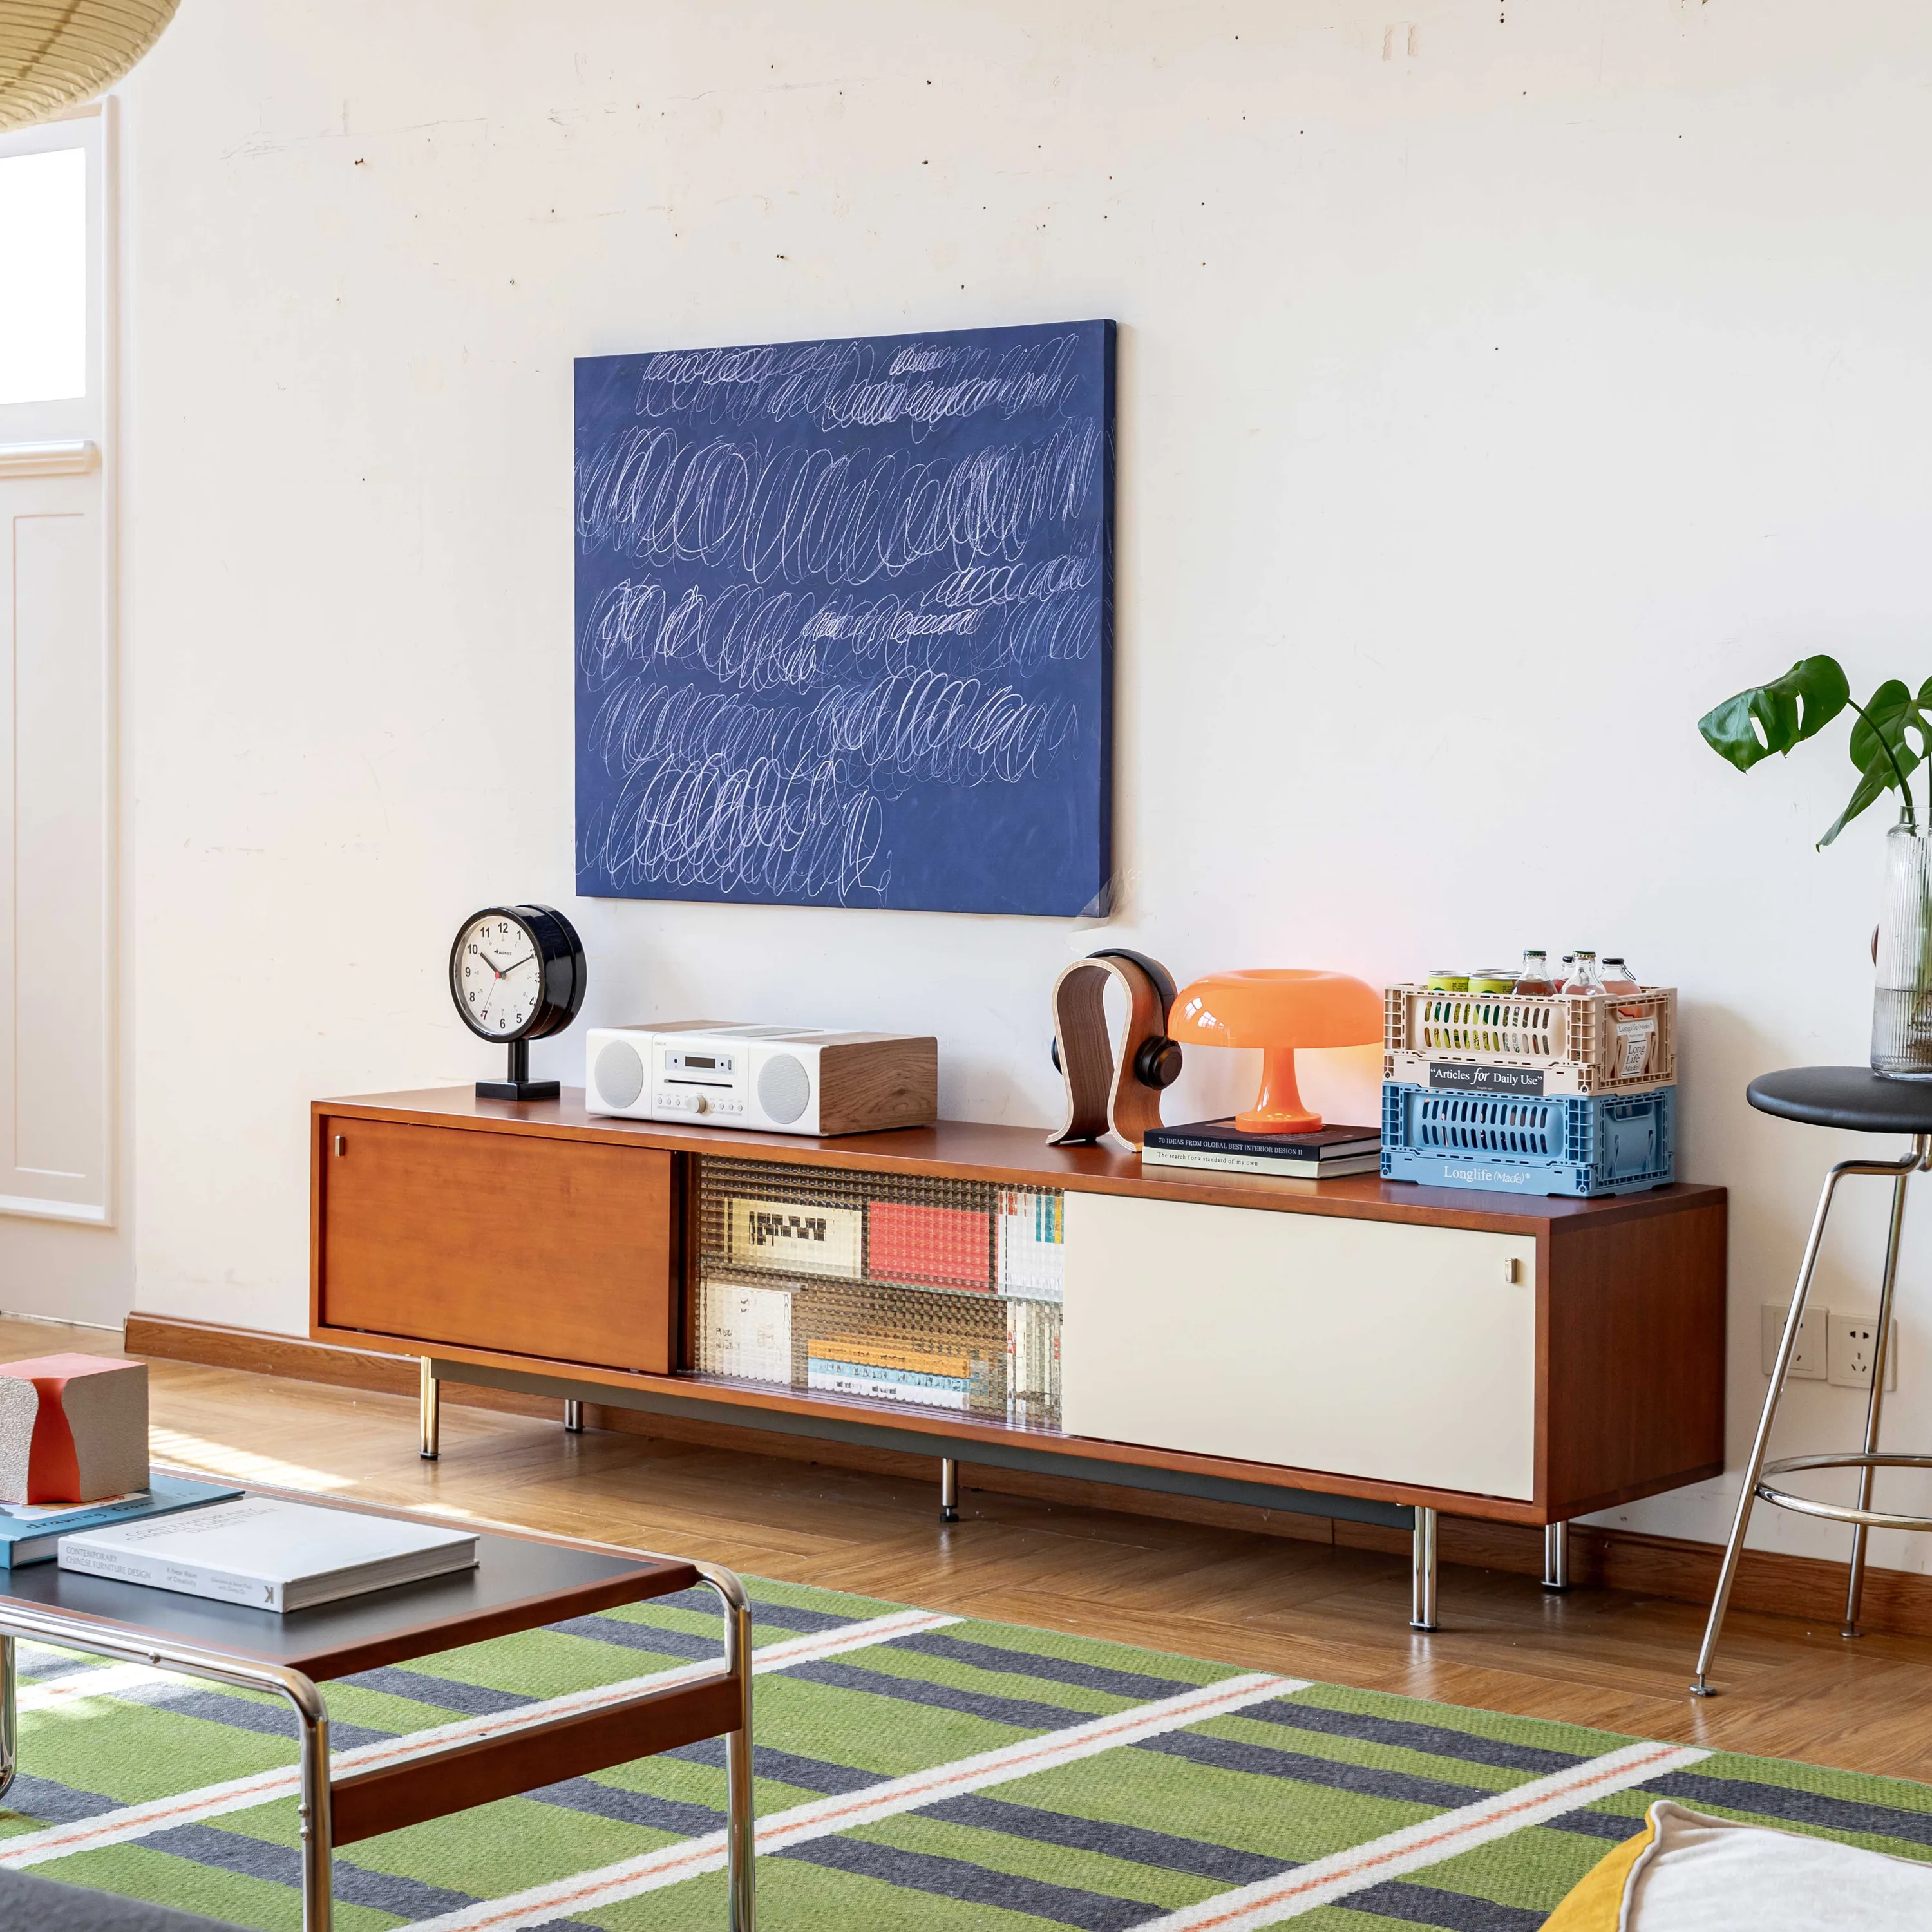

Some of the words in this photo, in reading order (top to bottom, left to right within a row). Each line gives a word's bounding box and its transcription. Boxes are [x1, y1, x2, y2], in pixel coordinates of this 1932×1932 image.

[480, 927, 490, 938] 11
[498, 922, 509, 933] 12
[517, 930, 521, 940] 1
[468, 943, 478, 954] 10
[465, 967, 471, 977] 9
[469, 992, 475, 1002] 8
[482, 1010, 488, 1021] 7
[516, 1014, 522, 1023] 5
[500, 1019, 506, 1029] 6
[1618, 1024, 1638, 1032] Longlife
[1628, 1045, 1645, 1055] Long
[1625, 1054, 1640, 1065] Life
[1470, 1067, 1490, 1085] for
[1493, 1072, 1519, 1086] Daily
[1444, 1166, 1492, 1182] Longlife
[26, 1512, 108, 1530] drawing
[111, 1501, 155, 1513] from
[125, 1508, 254, 1537] CONTEMPORARY
[66, 1546, 118, 1563] CONTEMPORARY
[66, 1556, 91, 1567] CHINESE
[93, 1562, 126, 1575] FURNITURE
[128, 1568, 151, 1579] DESIGN
